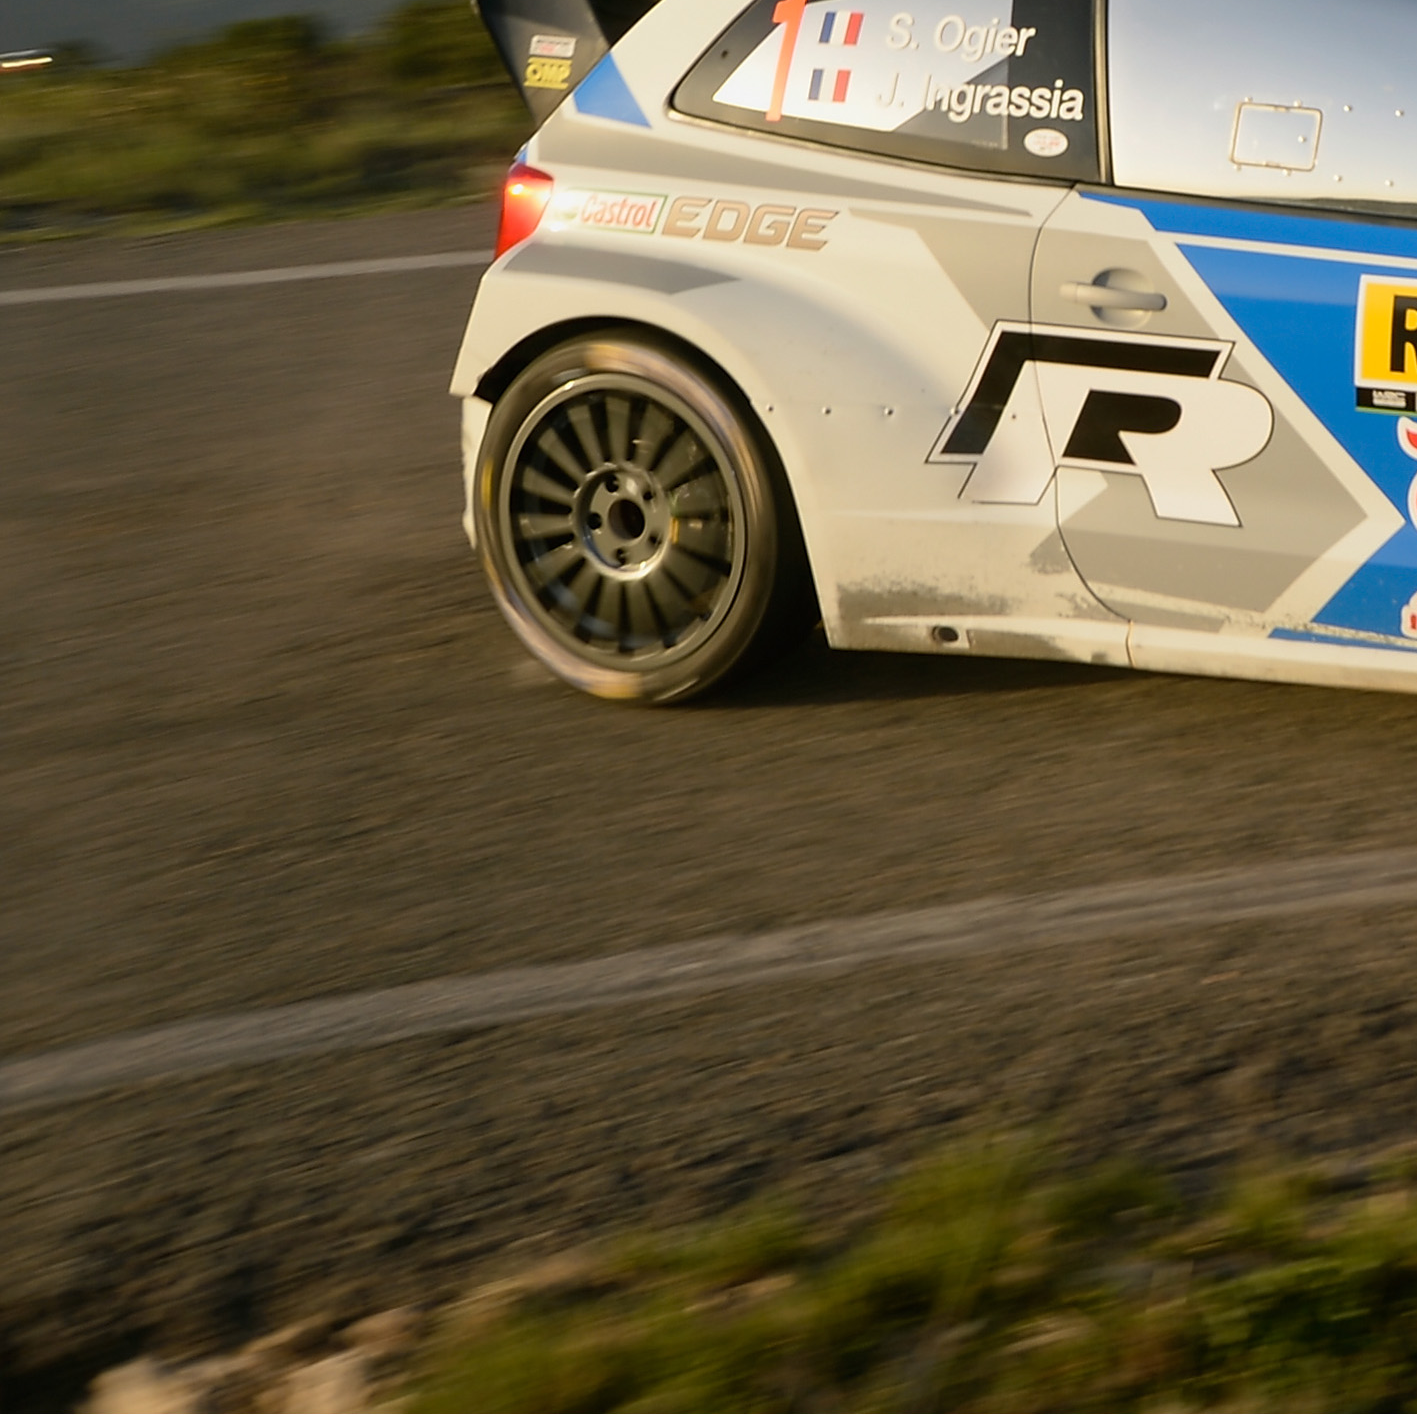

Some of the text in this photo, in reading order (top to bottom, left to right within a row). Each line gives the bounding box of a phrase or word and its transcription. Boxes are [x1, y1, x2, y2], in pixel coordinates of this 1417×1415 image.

[885, 12, 1036, 63] S. Ogier
[875, 72, 1084, 123] J. Ingrassia
[580, 194, 840, 252] Castrol EDGE
